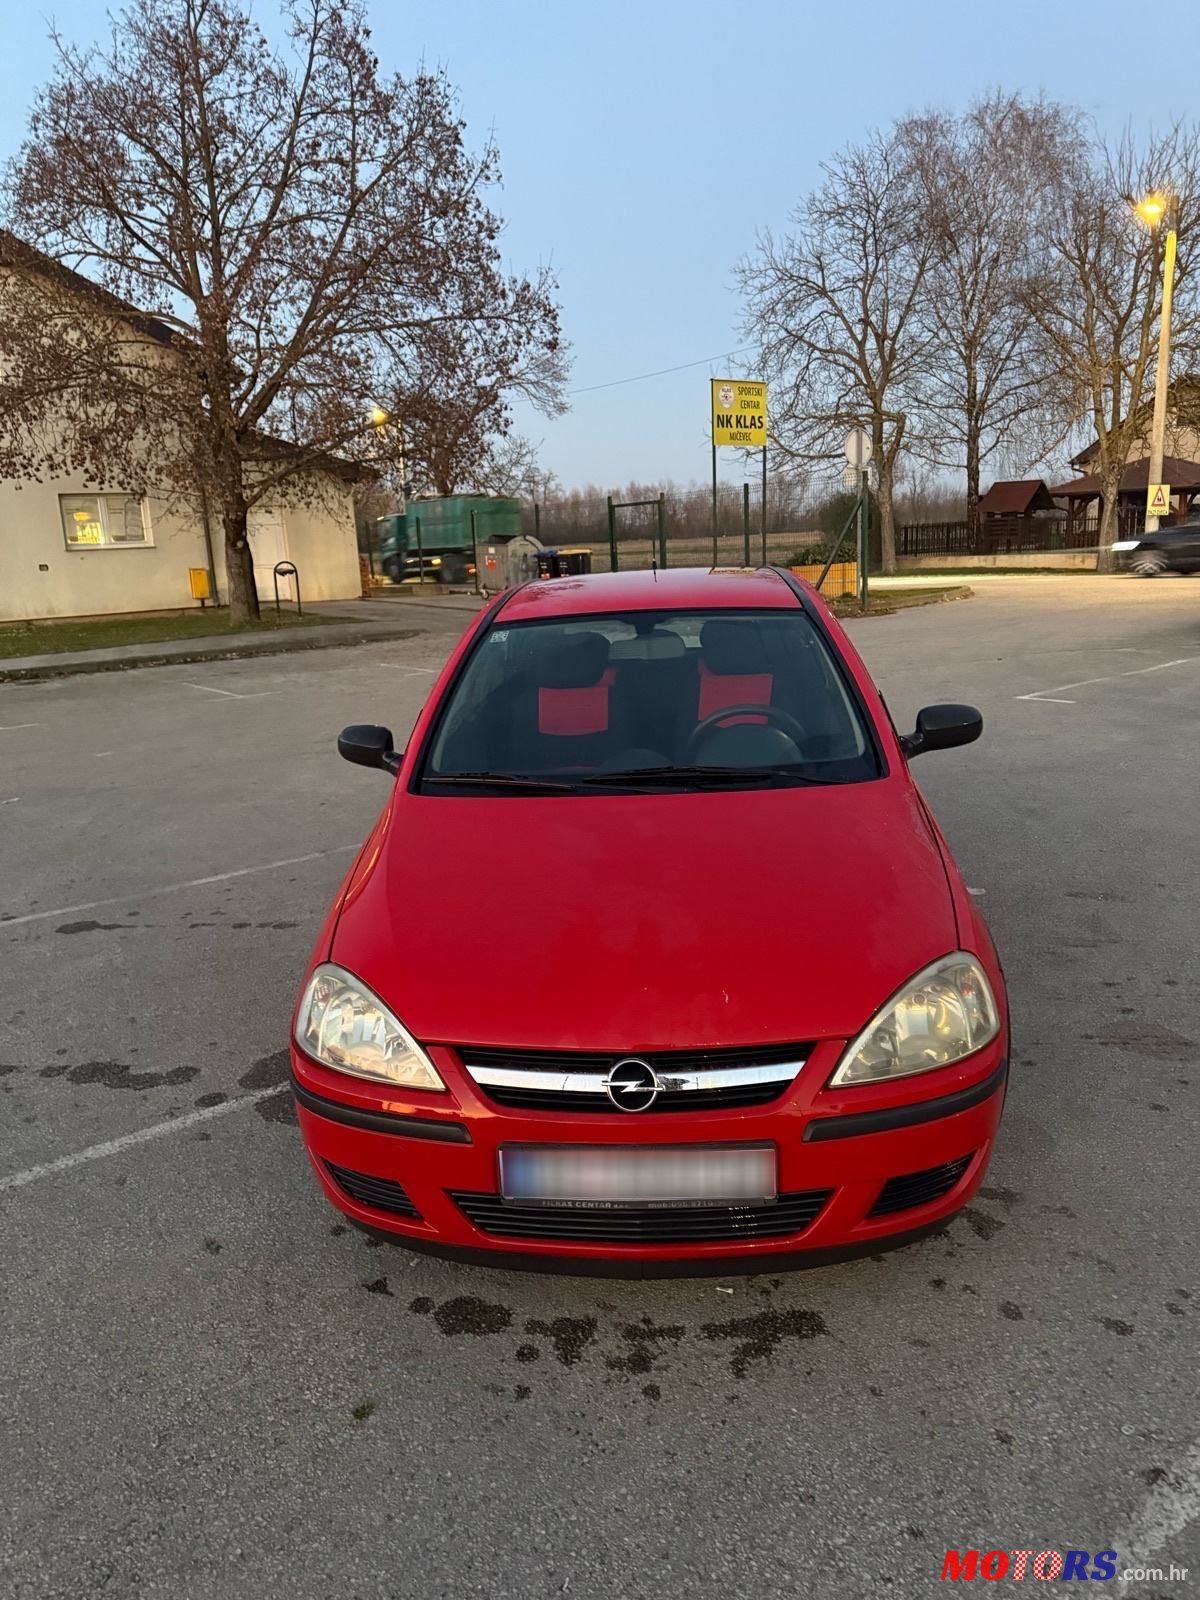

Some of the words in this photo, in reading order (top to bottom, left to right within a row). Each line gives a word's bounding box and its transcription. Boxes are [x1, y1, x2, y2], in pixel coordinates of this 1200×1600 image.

[737, 386, 763, 396] SPORTSKI
[740, 400, 761, 409] CENTAR
[716, 414, 733, 429] NK
[735, 414, 764, 430] KLAS
[729, 430, 752, 441] MIČEVEC
[575, 1201, 611, 1209] CENTAR
